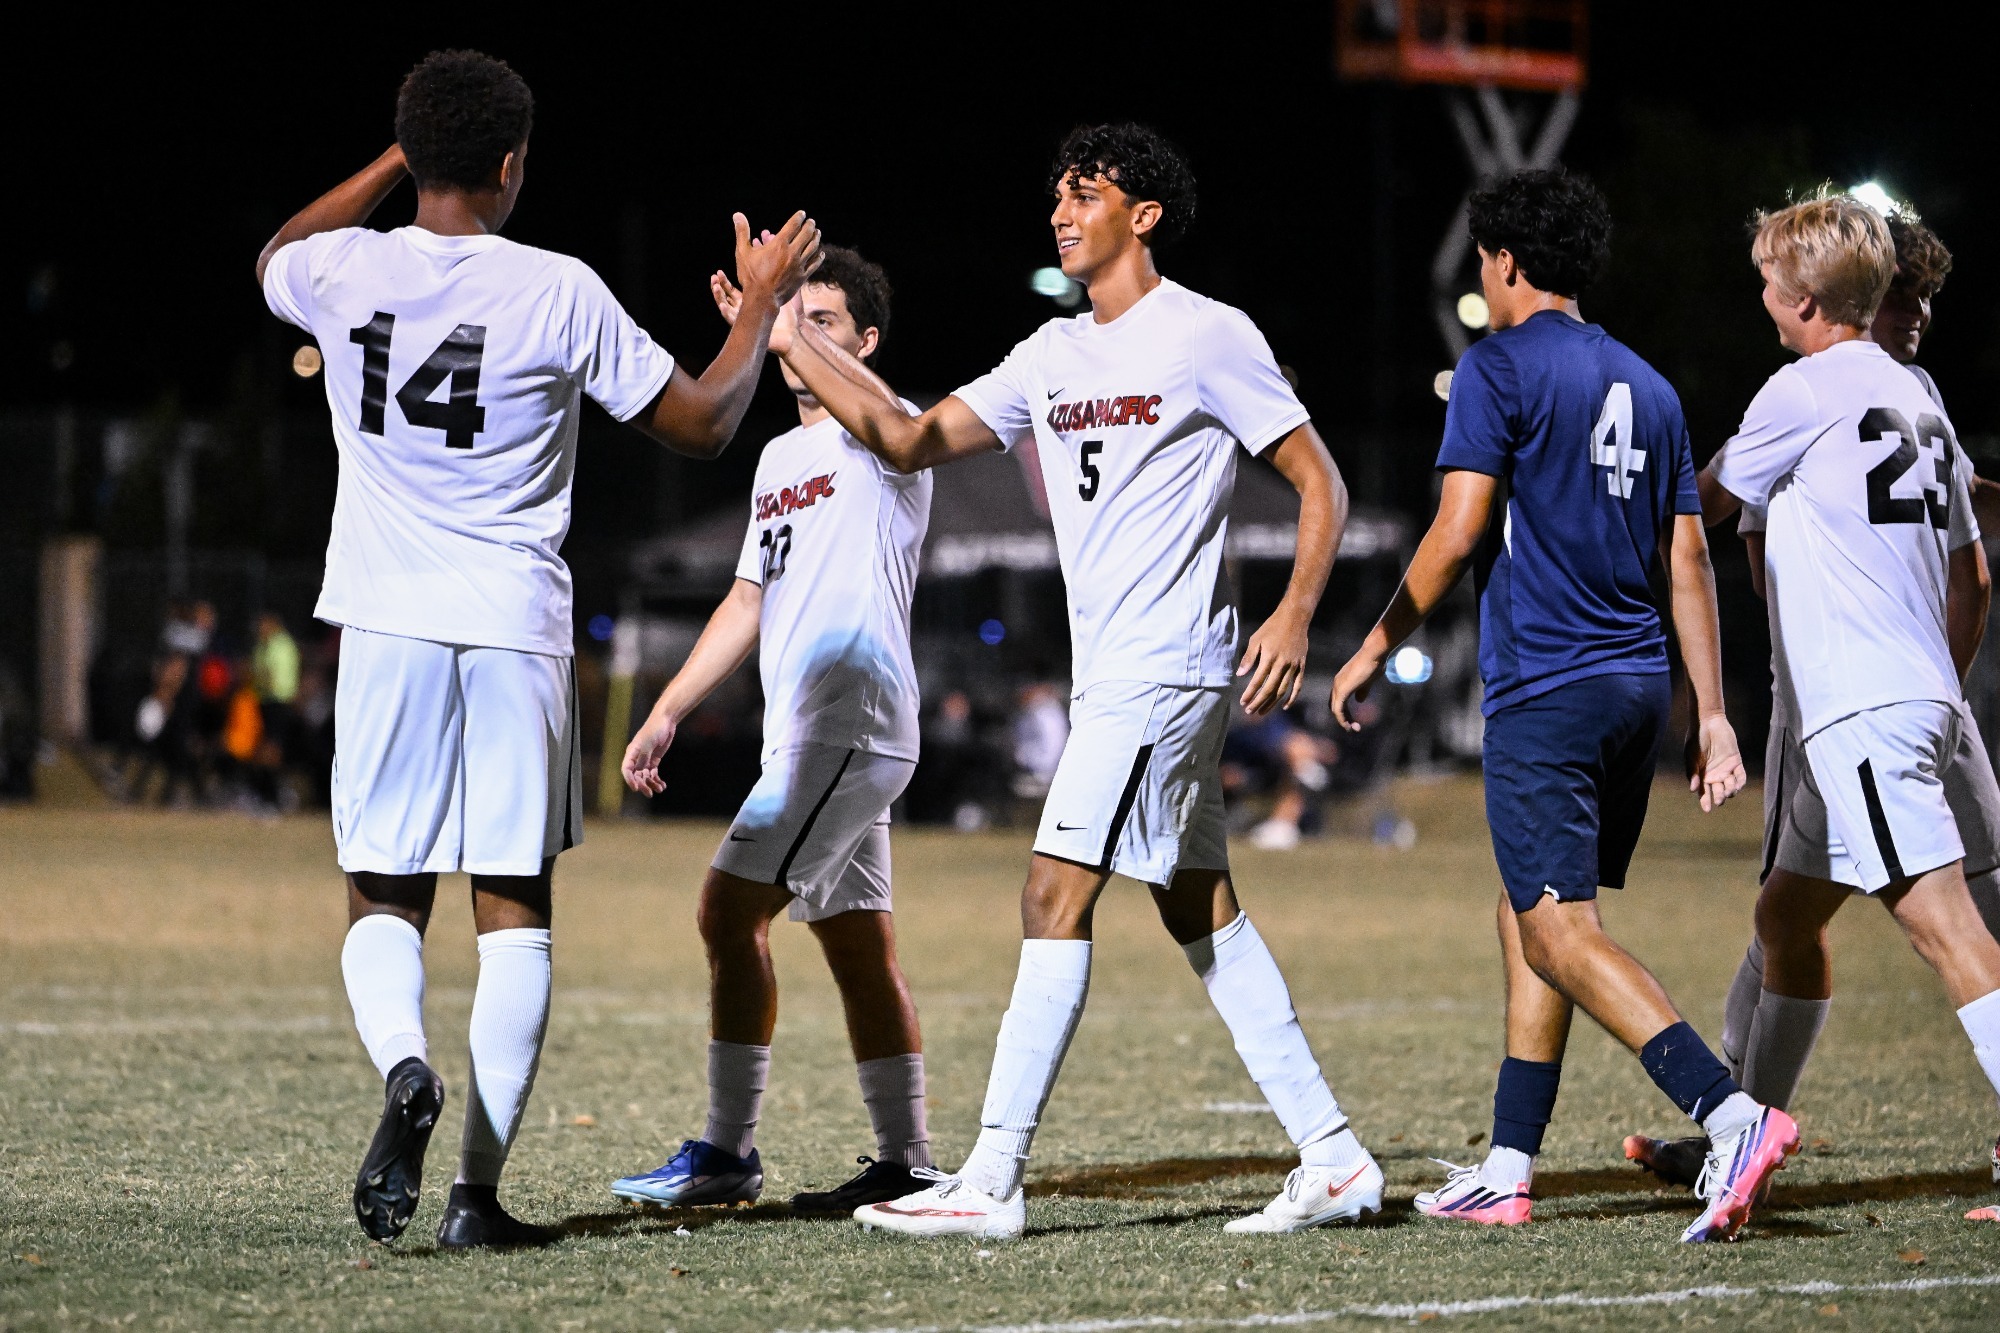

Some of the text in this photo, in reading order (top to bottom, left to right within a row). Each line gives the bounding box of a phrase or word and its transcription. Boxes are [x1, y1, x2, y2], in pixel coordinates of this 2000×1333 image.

[349, 311, 487, 449] 14
[1078, 440, 1103, 502] 5
[1589, 382, 1647, 500] 4
[1857, 407, 1955, 530] 23
